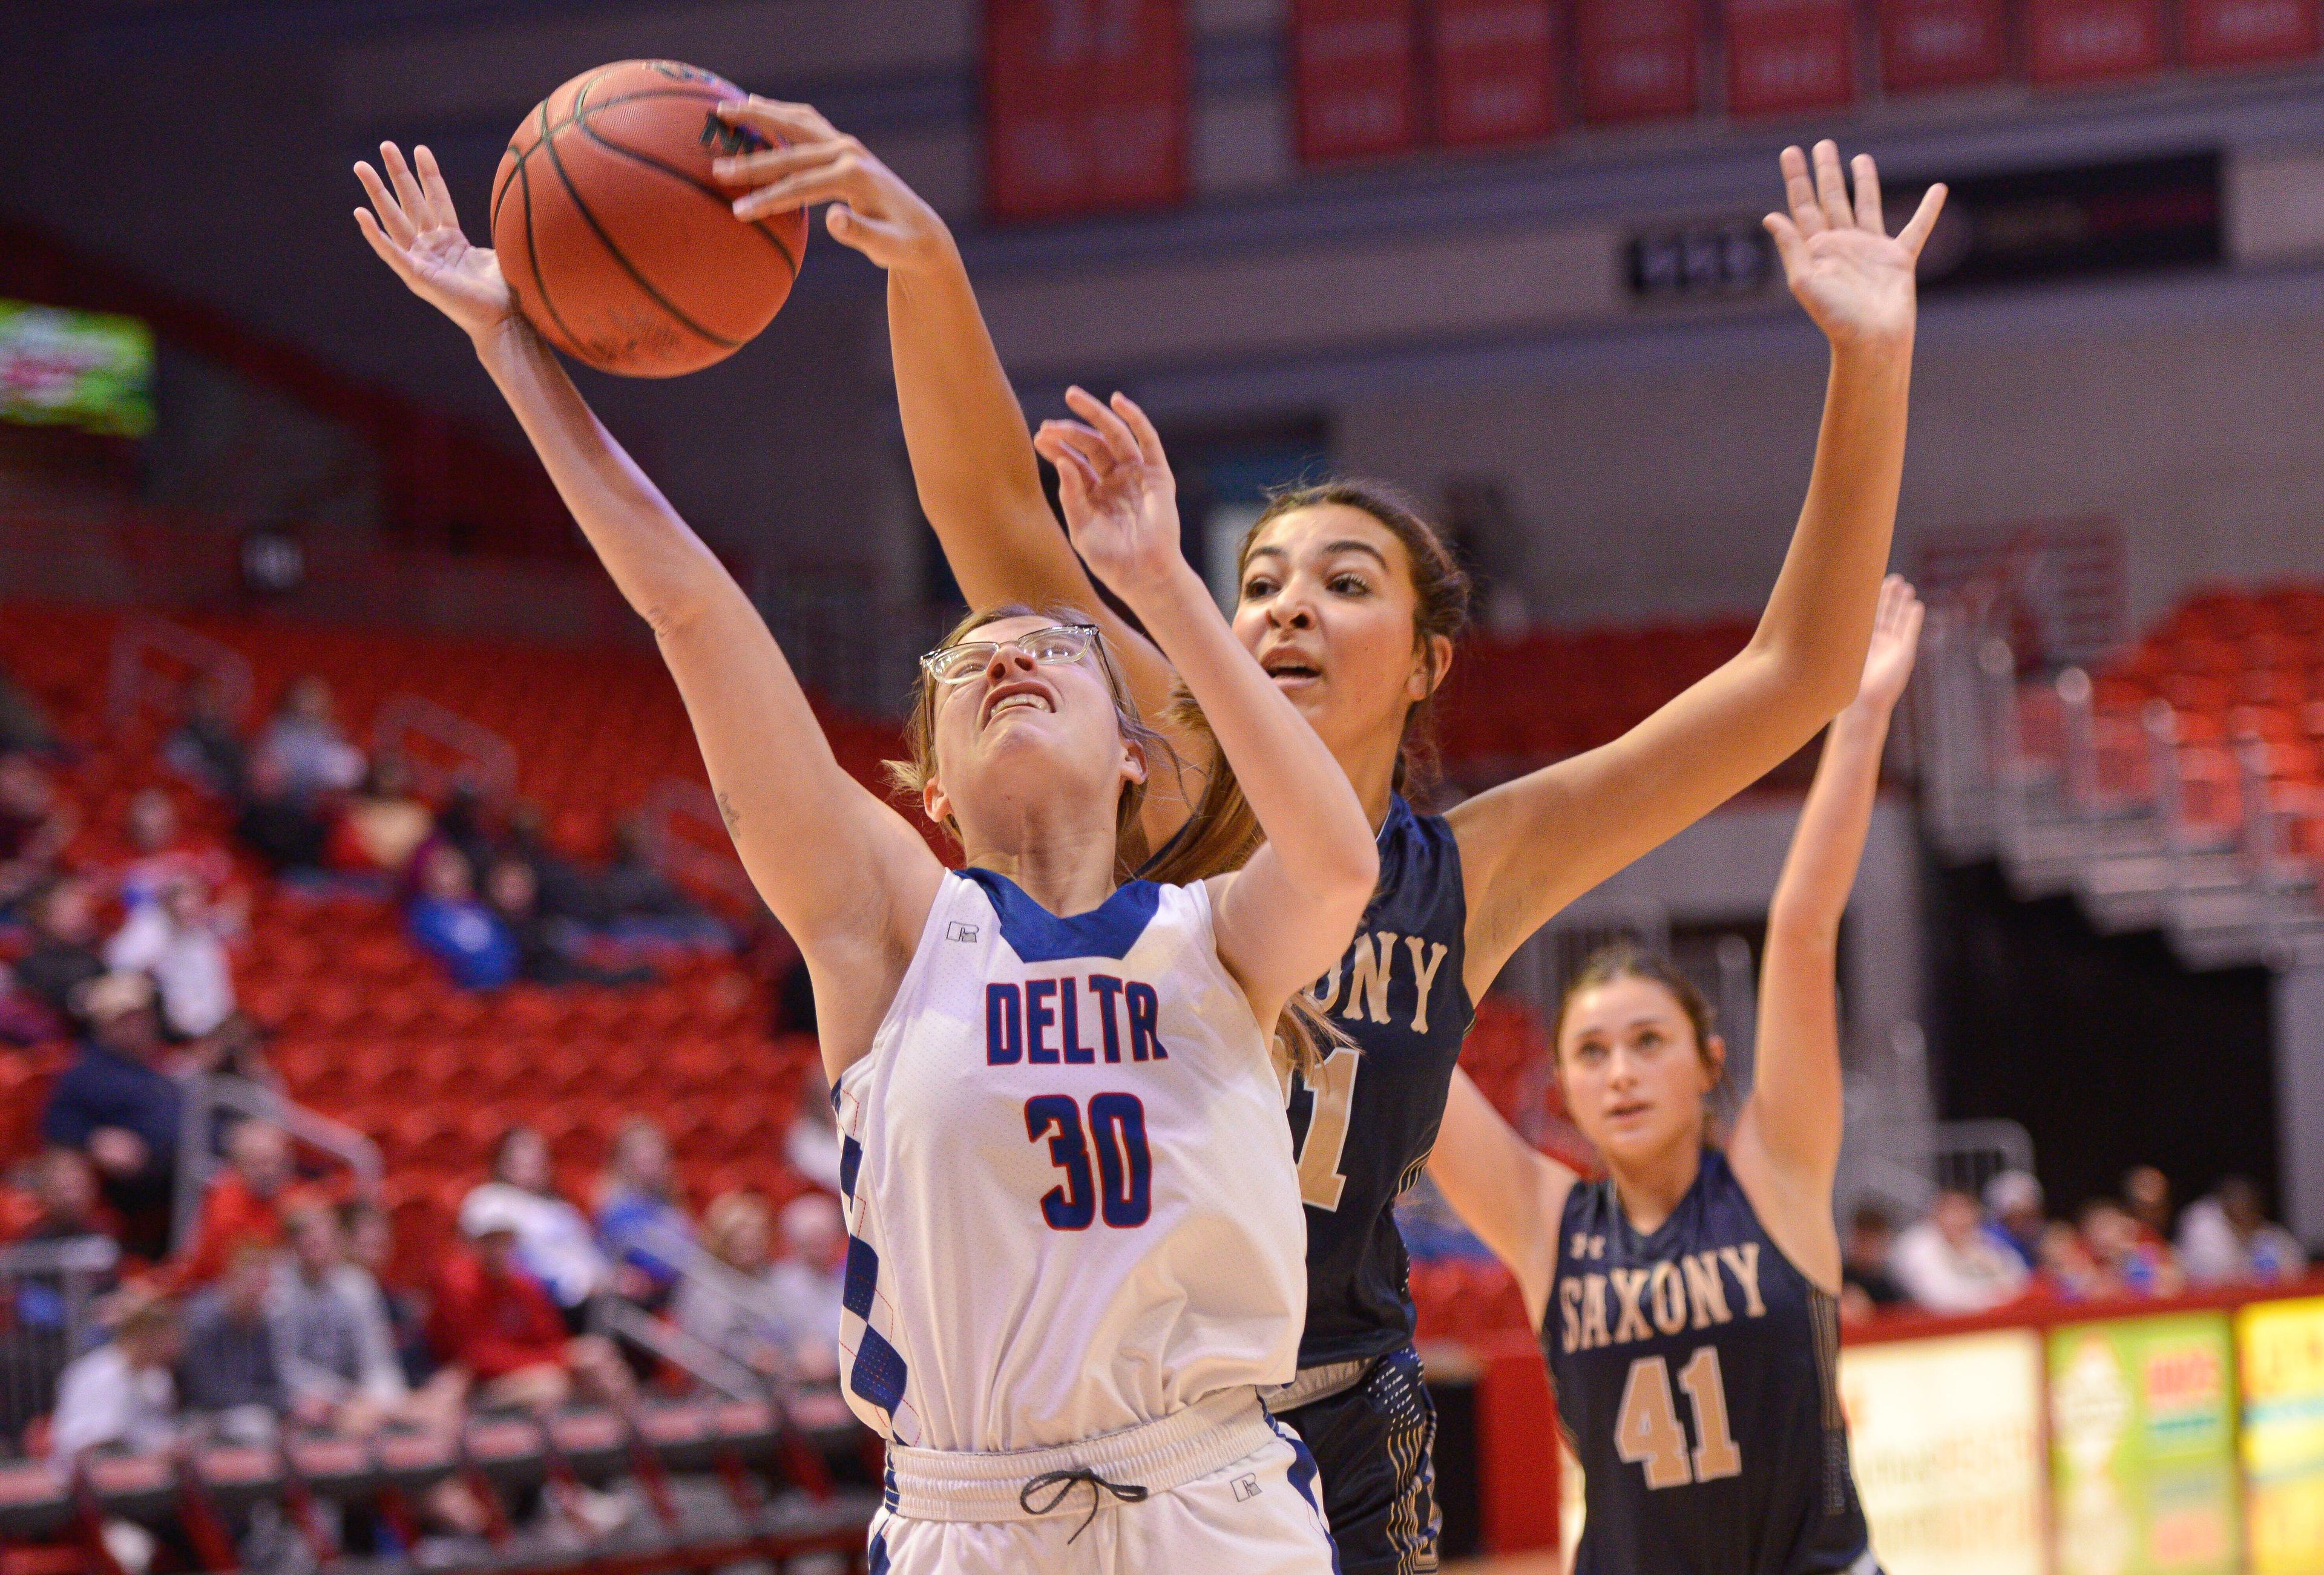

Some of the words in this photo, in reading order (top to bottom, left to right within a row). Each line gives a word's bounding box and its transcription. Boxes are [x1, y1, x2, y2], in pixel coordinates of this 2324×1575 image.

[985, 974, 1168, 1066] DELTA
[1304, 931, 1448, 1034] ONY
[1025, 1092, 1152, 1231] 30
[1273, 1035, 1360, 1213] 1
[1559, 1242, 1768, 1355] SAXONY
[1614, 1345, 1742, 1491] 41
